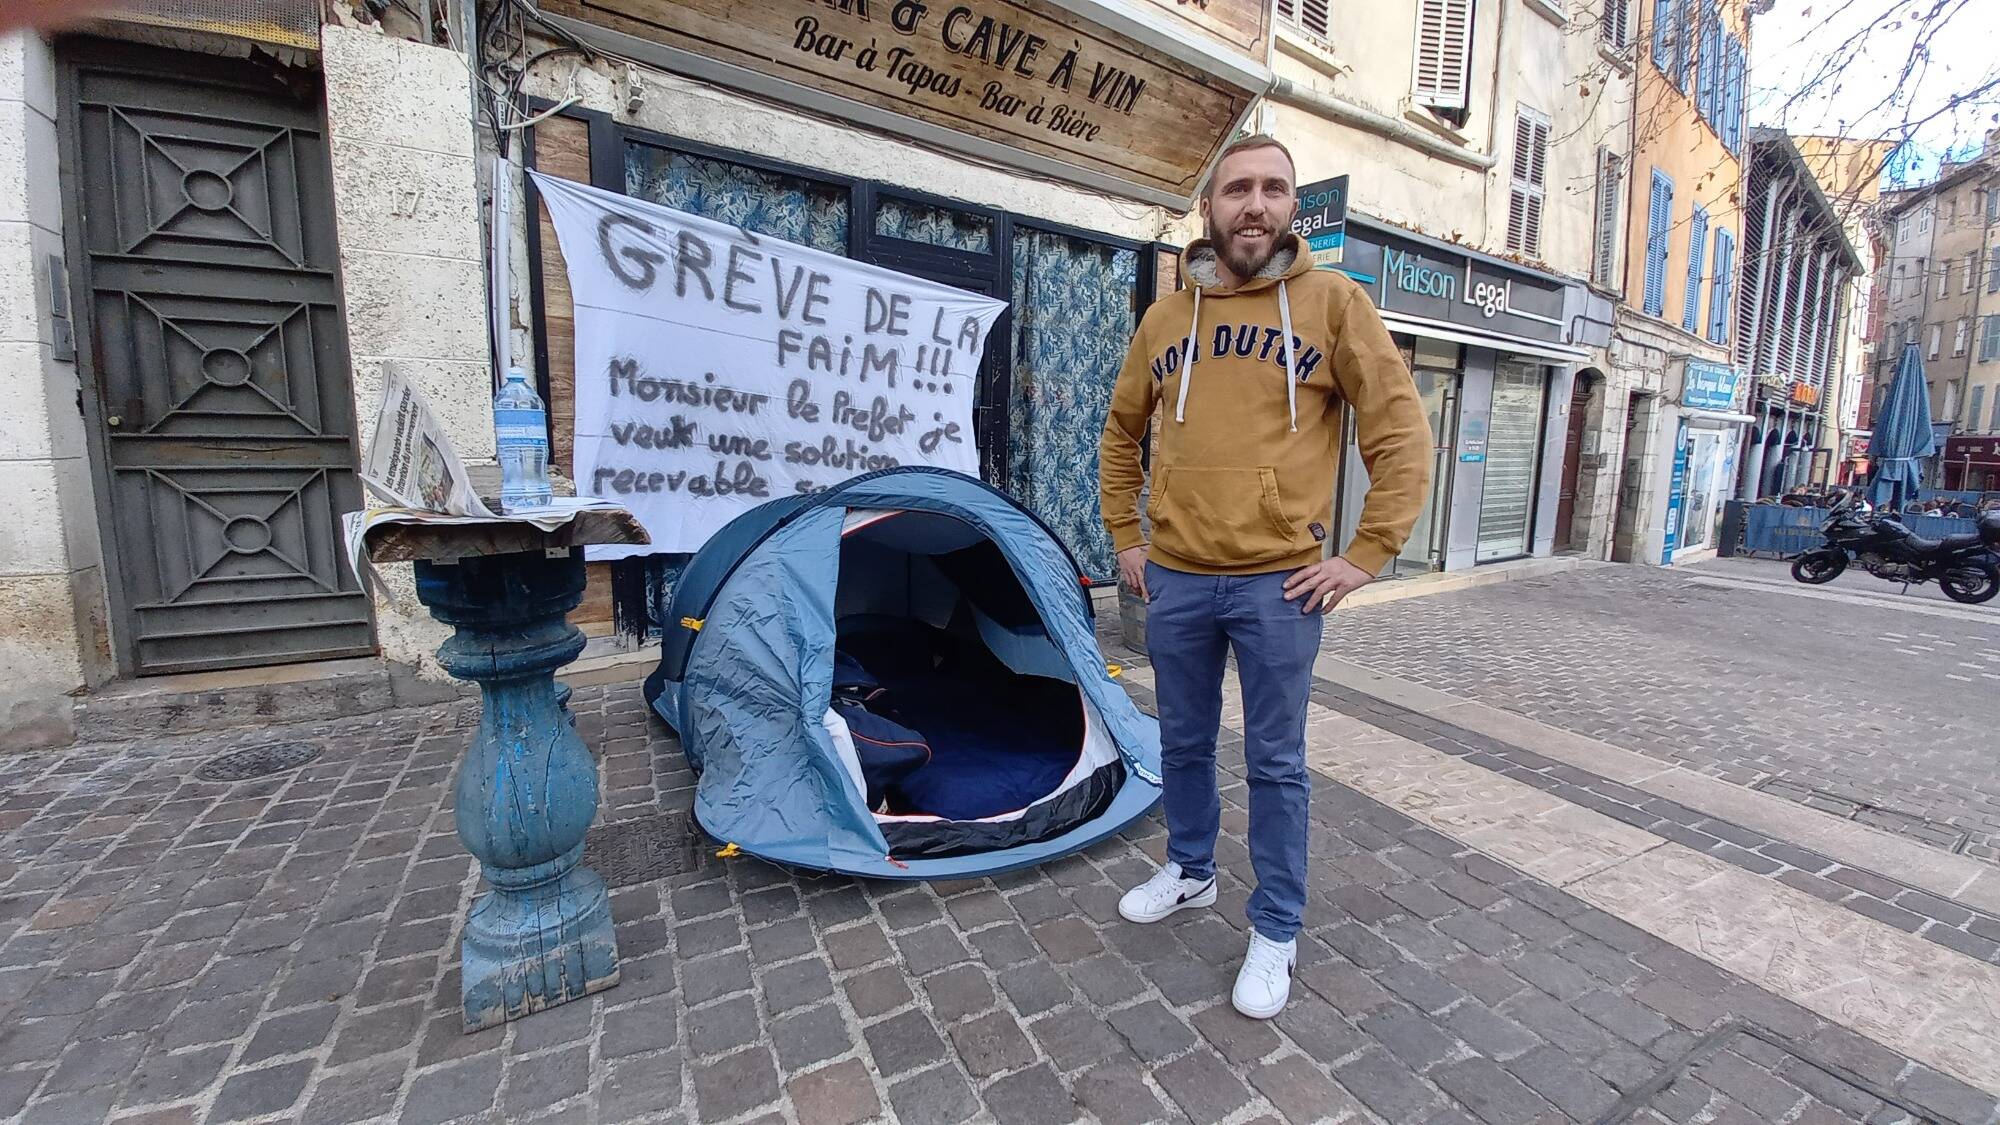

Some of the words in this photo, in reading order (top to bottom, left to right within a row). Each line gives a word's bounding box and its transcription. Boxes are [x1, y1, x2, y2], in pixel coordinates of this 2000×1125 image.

[793, 16, 853, 61] Bar
[855, 37, 880, 72] à
[886, 47, 962, 98] Tapas
[979, 80, 1026, 117] Bar
[1026, 97, 1046, 125] à
[1047, 104, 1101, 142] Bière
[941, 6, 1047, 79] CAVE
[1047, 39, 1082, 93] À
[1087, 61, 1147, 116] VIN
[1291, 207, 1342, 236] egal
[1297, 188, 1340, 211] ison
[1309, 236, 1336, 249] NERIE
[597, 213, 831, 325] GRÈVE
[865, 287, 912, 336] DE
[932, 306, 981, 355] LA
[1380, 245, 1456, 308] Maison
[1463, 256, 1535, 322] Legal
[1211, 323, 1324, 384] DUTCH
[608, 357, 769, 417] Monsieur
[786, 377, 820, 423] le
[919, 411, 963, 454] je
[708, 433, 773, 462] une
[593, 460, 771, 498] recevable
